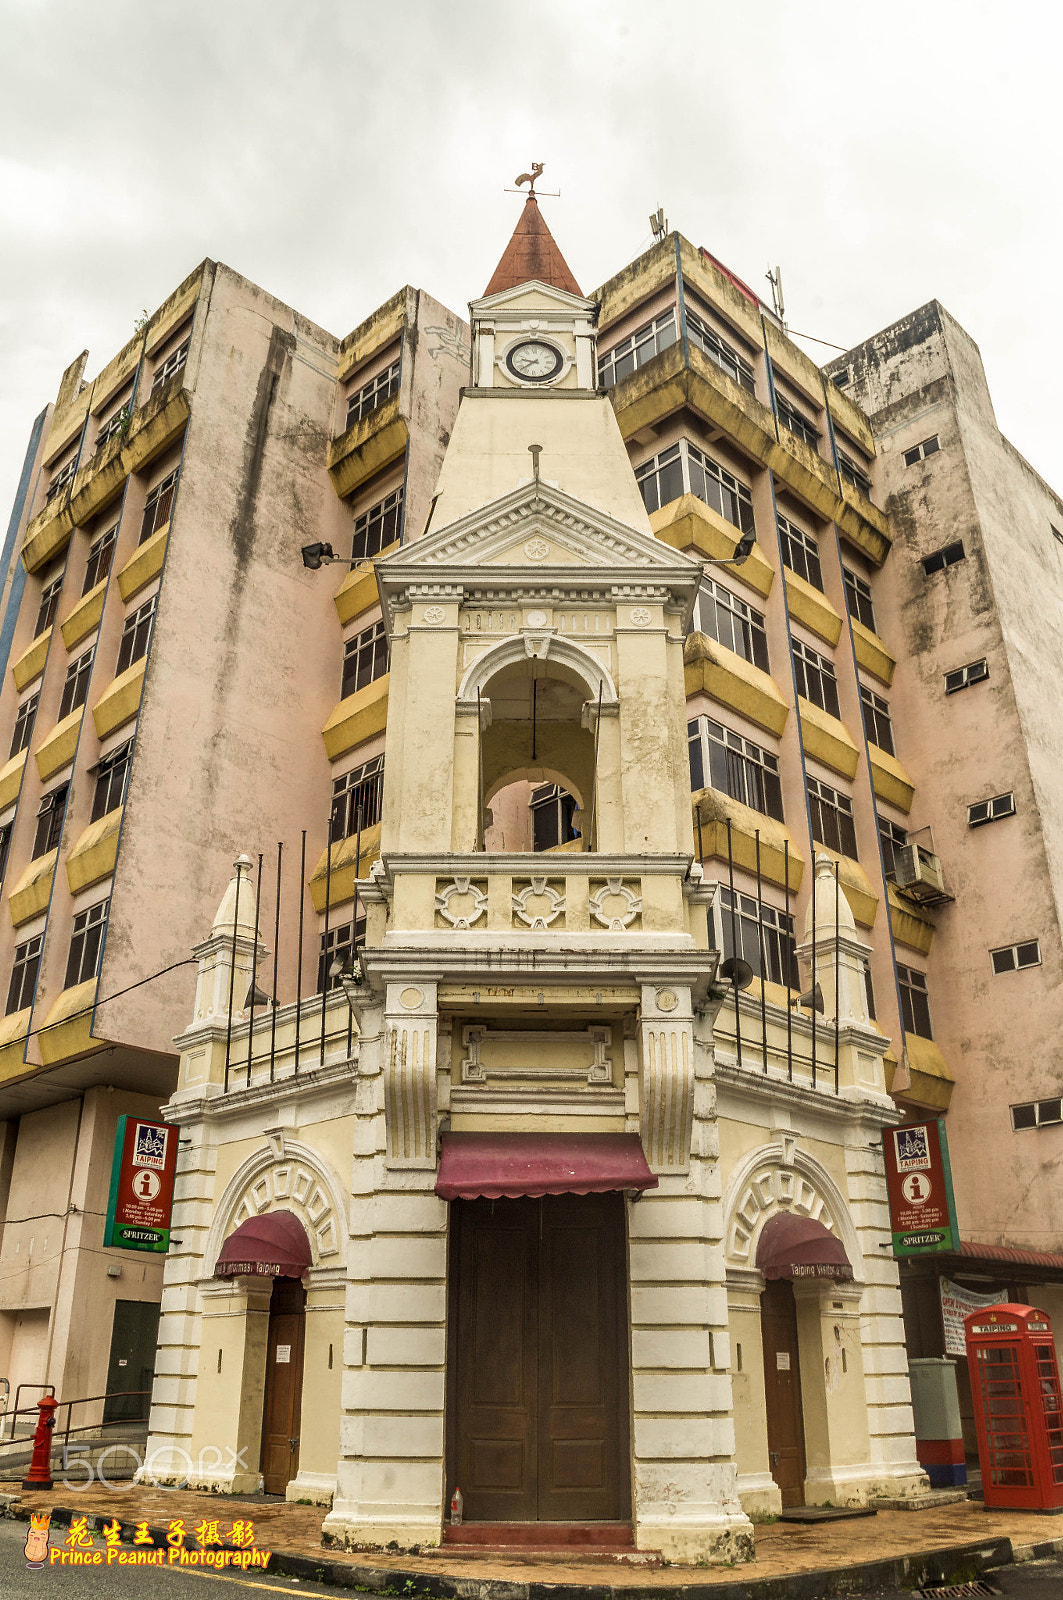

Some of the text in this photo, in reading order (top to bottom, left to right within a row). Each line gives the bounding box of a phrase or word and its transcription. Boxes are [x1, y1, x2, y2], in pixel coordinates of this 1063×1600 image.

[136, 1155, 163, 1165] TAIPING
[899, 1158, 928, 1167] TAIPING
[122, 1230, 158, 1241] SPRITZER
[903, 1234, 940, 1246] SPRITZER
[256, 1262, 280, 1275] Taiping
[791, 1264, 815, 1276] Taiping
